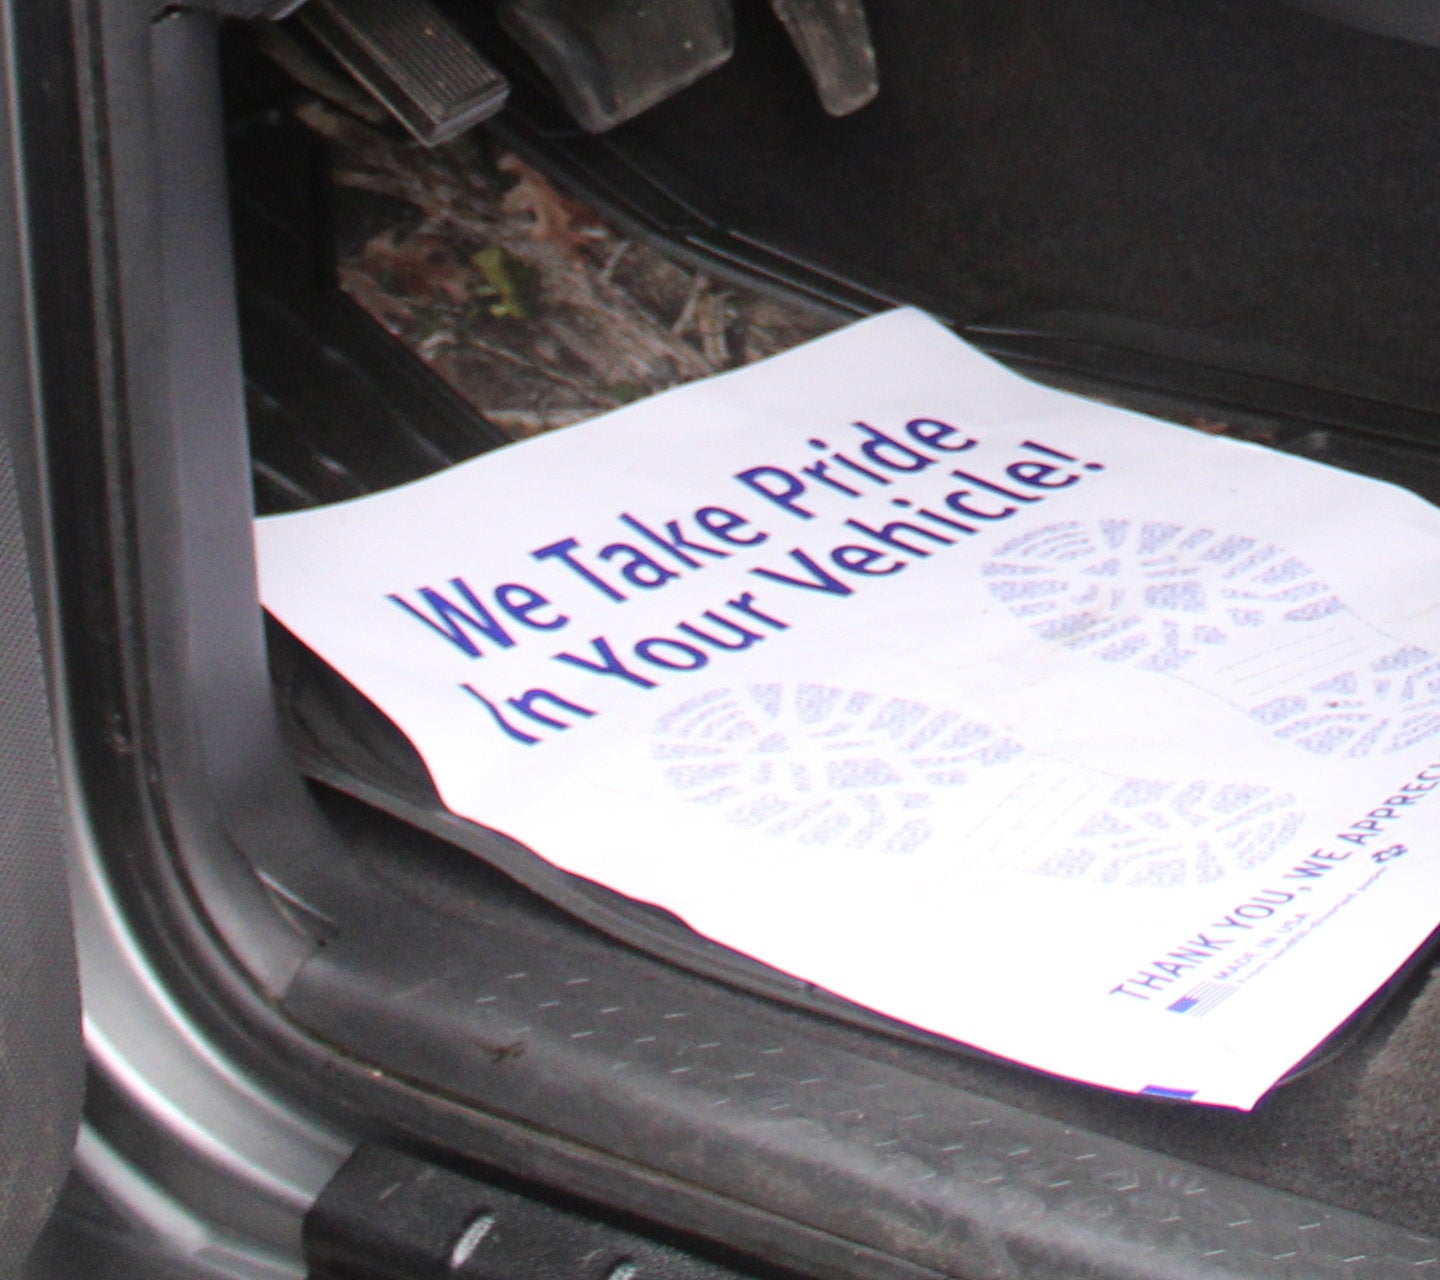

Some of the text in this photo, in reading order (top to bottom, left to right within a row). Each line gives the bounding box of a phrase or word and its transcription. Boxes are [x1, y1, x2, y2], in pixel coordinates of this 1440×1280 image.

[386, 415, 979, 661] We Take Pride
[460, 439, 1106, 746] In Your Vehicle!
[1108, 933, 1235, 1000] THANK
[1282, 848, 1353, 879] WE
[1213, 952, 1257, 980] MADE
[1276, 912, 1310, 934] USA
